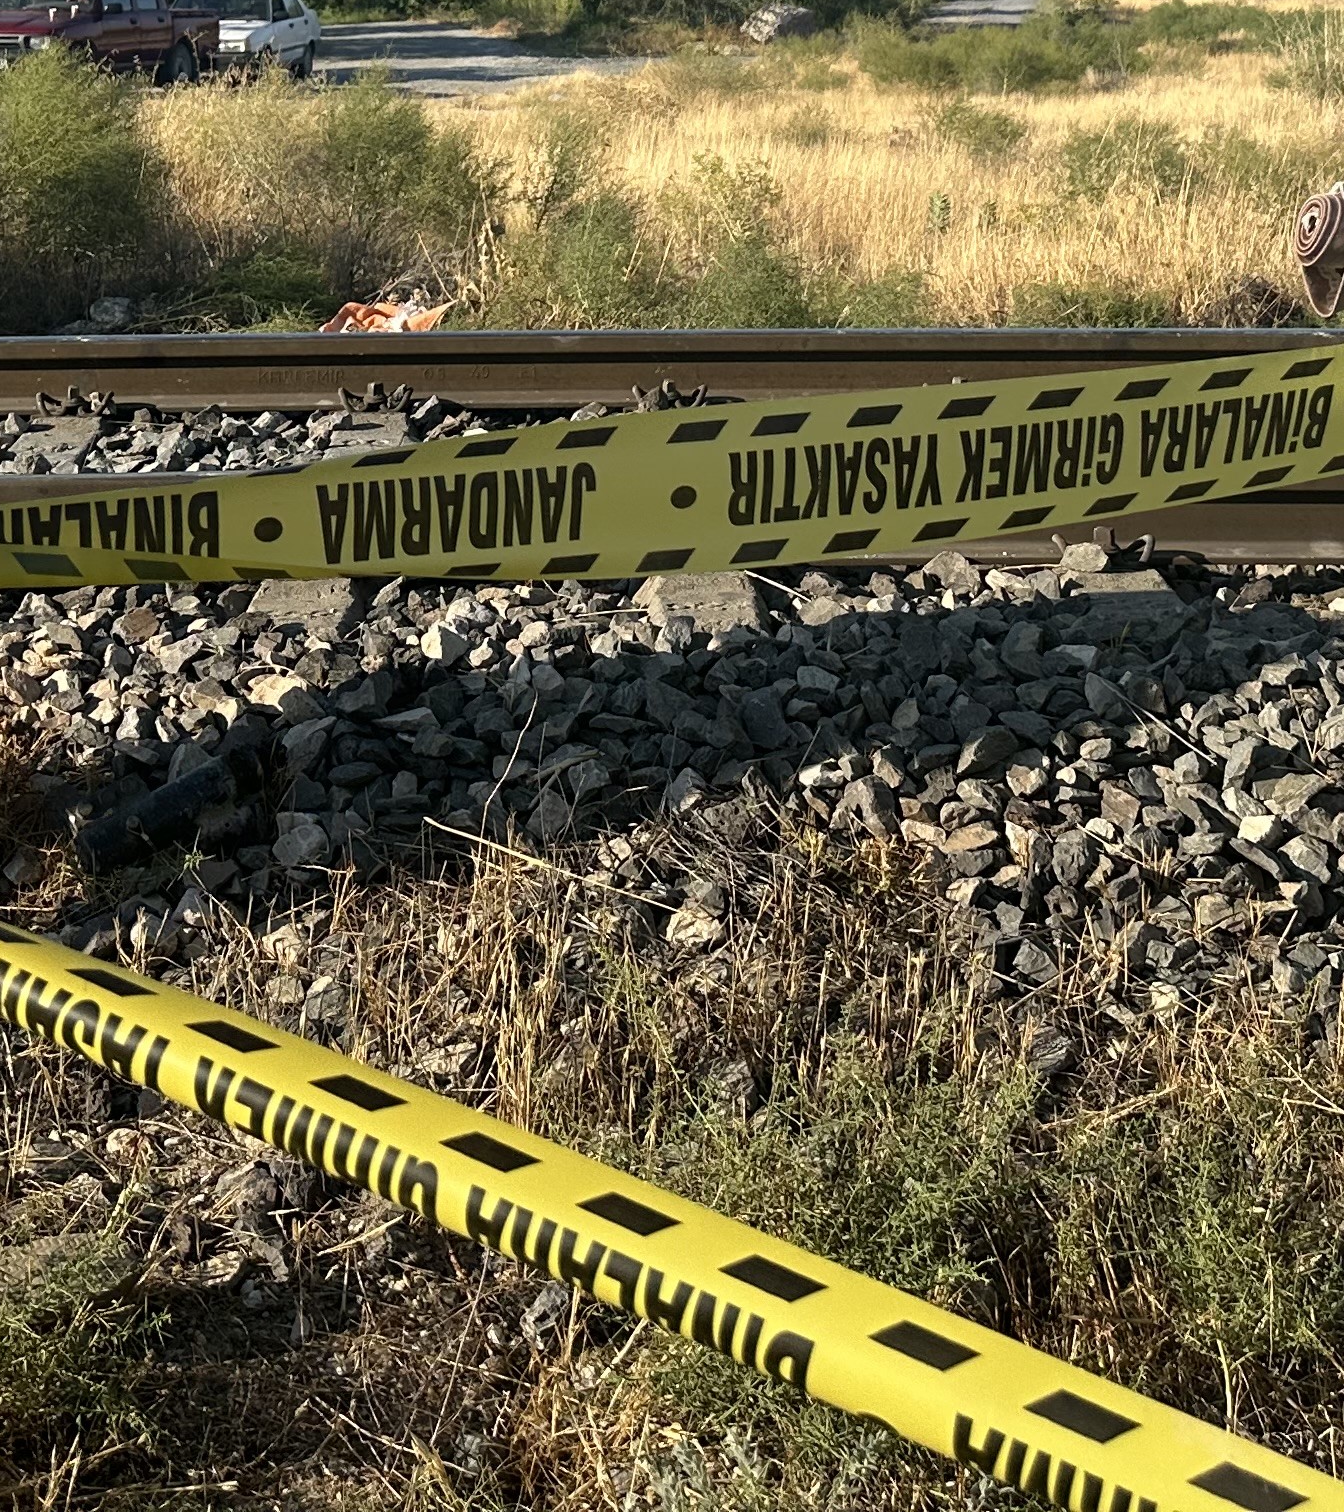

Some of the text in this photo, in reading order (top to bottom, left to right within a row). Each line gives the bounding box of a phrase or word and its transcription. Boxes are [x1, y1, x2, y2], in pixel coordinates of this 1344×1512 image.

[315, 461, 597, 565] JANDARMA
[726, 384, 1335, 527] BİNALARA GİRMEK YASAKTIR
